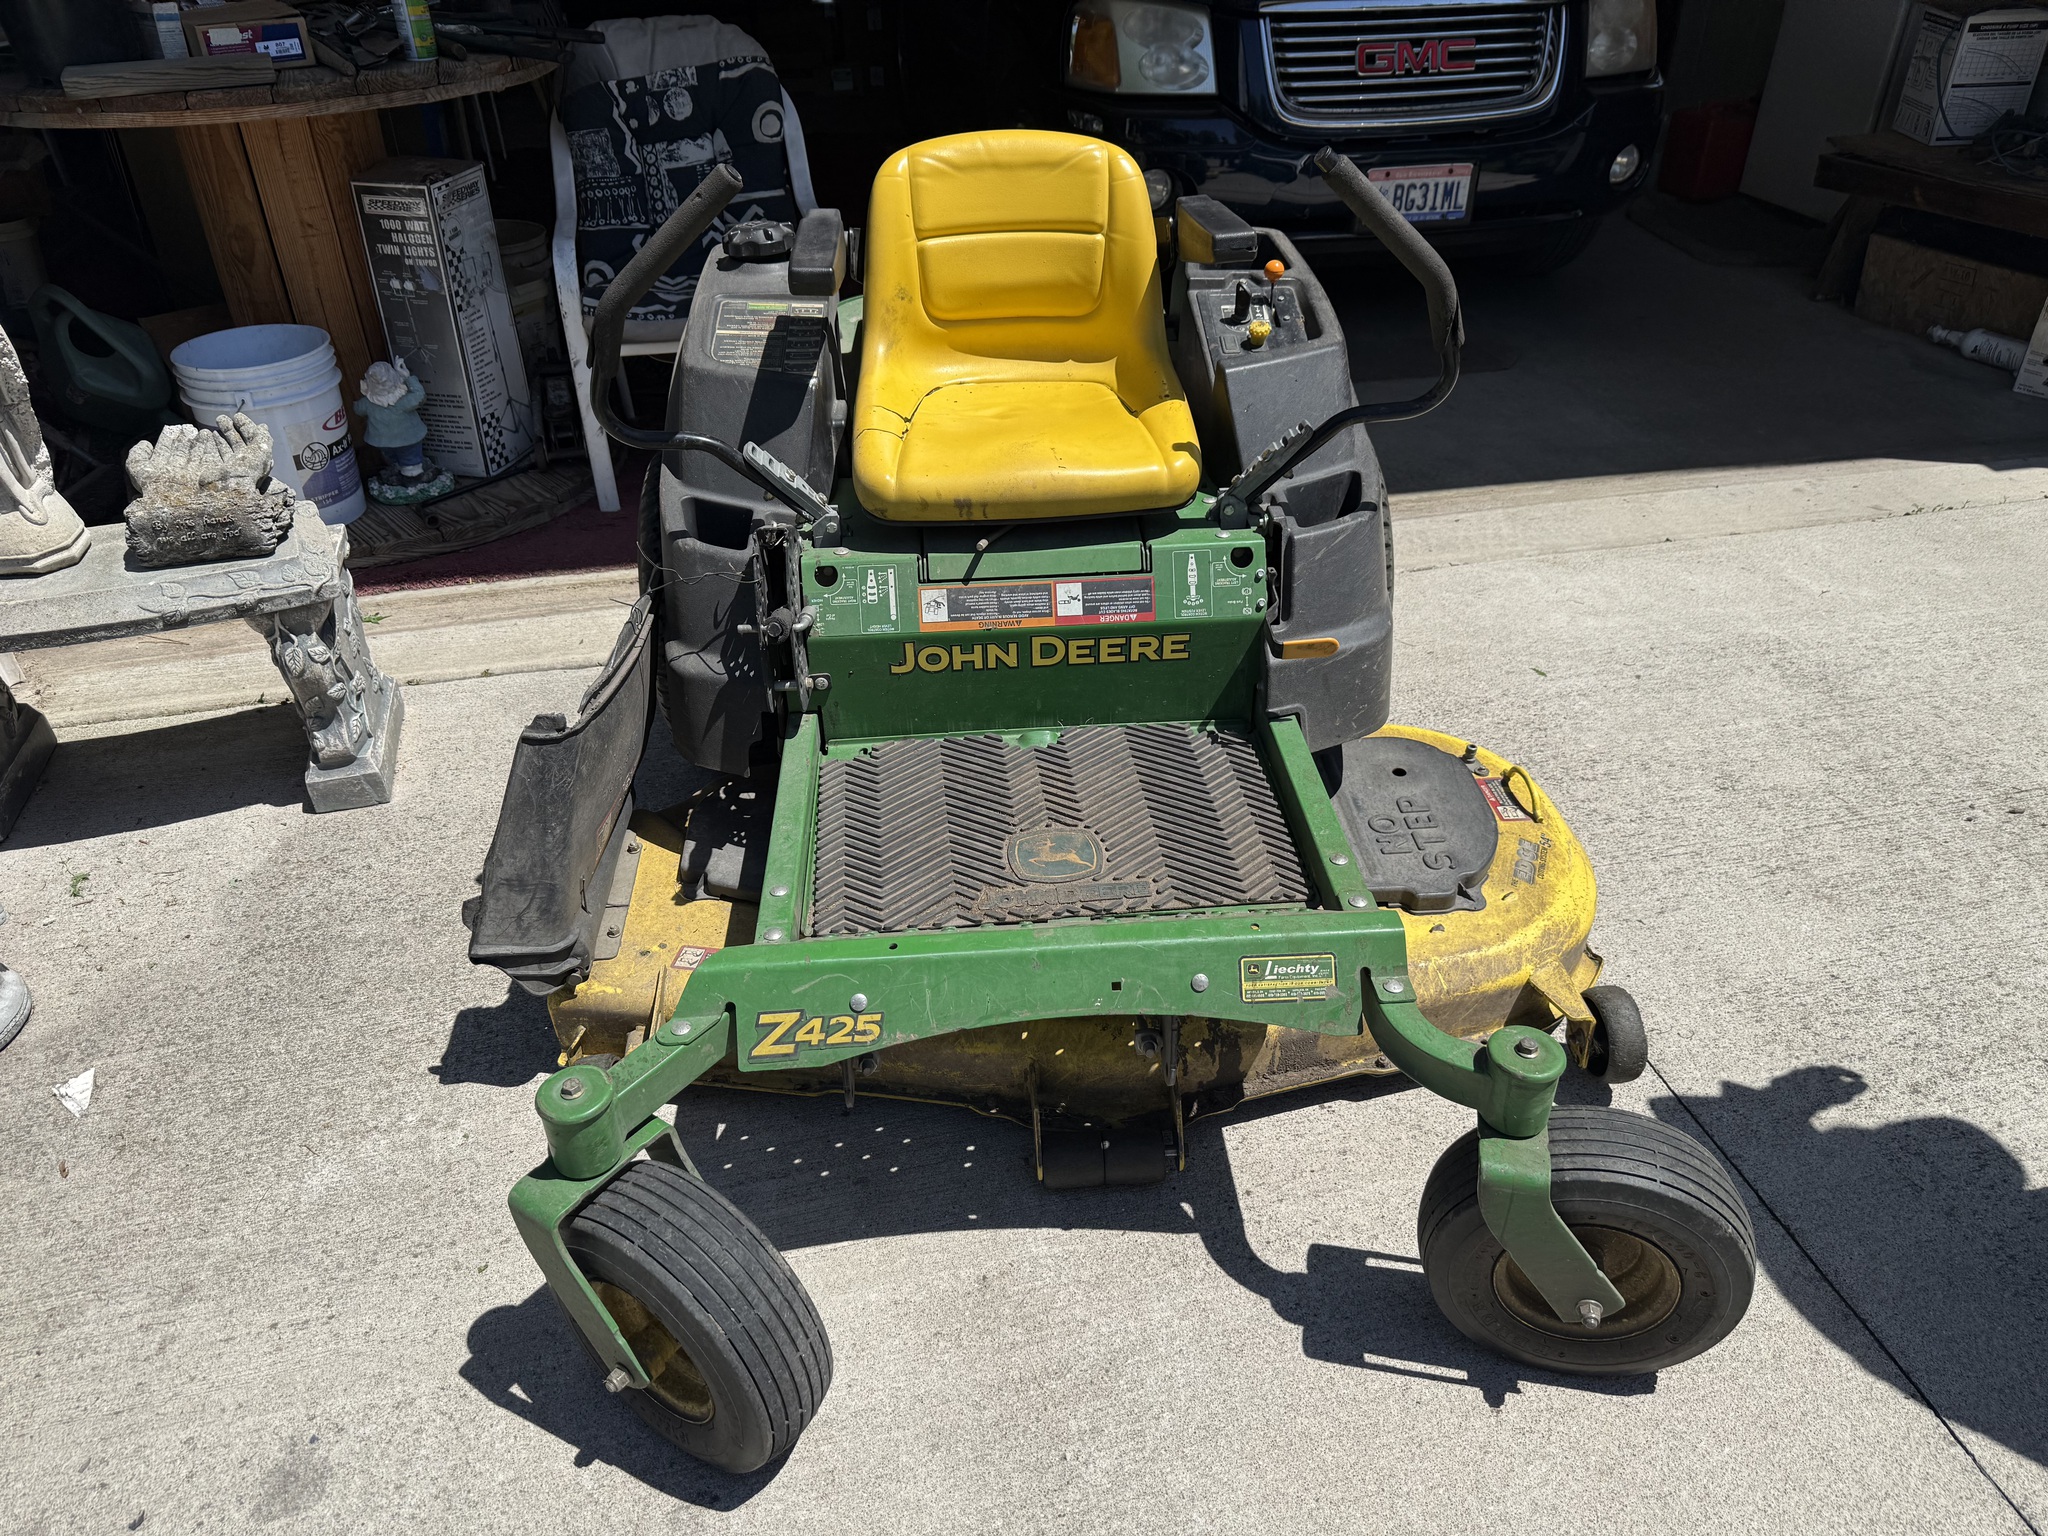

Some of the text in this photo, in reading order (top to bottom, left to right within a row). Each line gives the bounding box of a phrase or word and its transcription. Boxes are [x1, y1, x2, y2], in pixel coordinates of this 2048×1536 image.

[1356, 38, 1476, 76] GMC
[368, 198, 421, 206] SPEEDWAY
[1393, 181, 1464, 211] BG31ML
[379, 218, 430, 232] 1000 WATT
[391, 232, 434, 245] HALOGEN
[376, 244, 436, 258] TWIN LIGHTS
[416, 259, 438, 267] TRIPOD
[978, 620, 1015, 628] WARNING
[1099, 614, 1129, 622] DANGER
[890, 633, 1191, 675] JOHN DEERE
[1368, 814, 1412, 855] NO
[1396, 796, 1457, 871] STEP
[1513, 838, 1540, 885] EDGE
[1055, 882, 1151, 904] DEERE
[1264, 961, 1319, 979] Liechty
[749, 1010, 883, 1058] Z425
